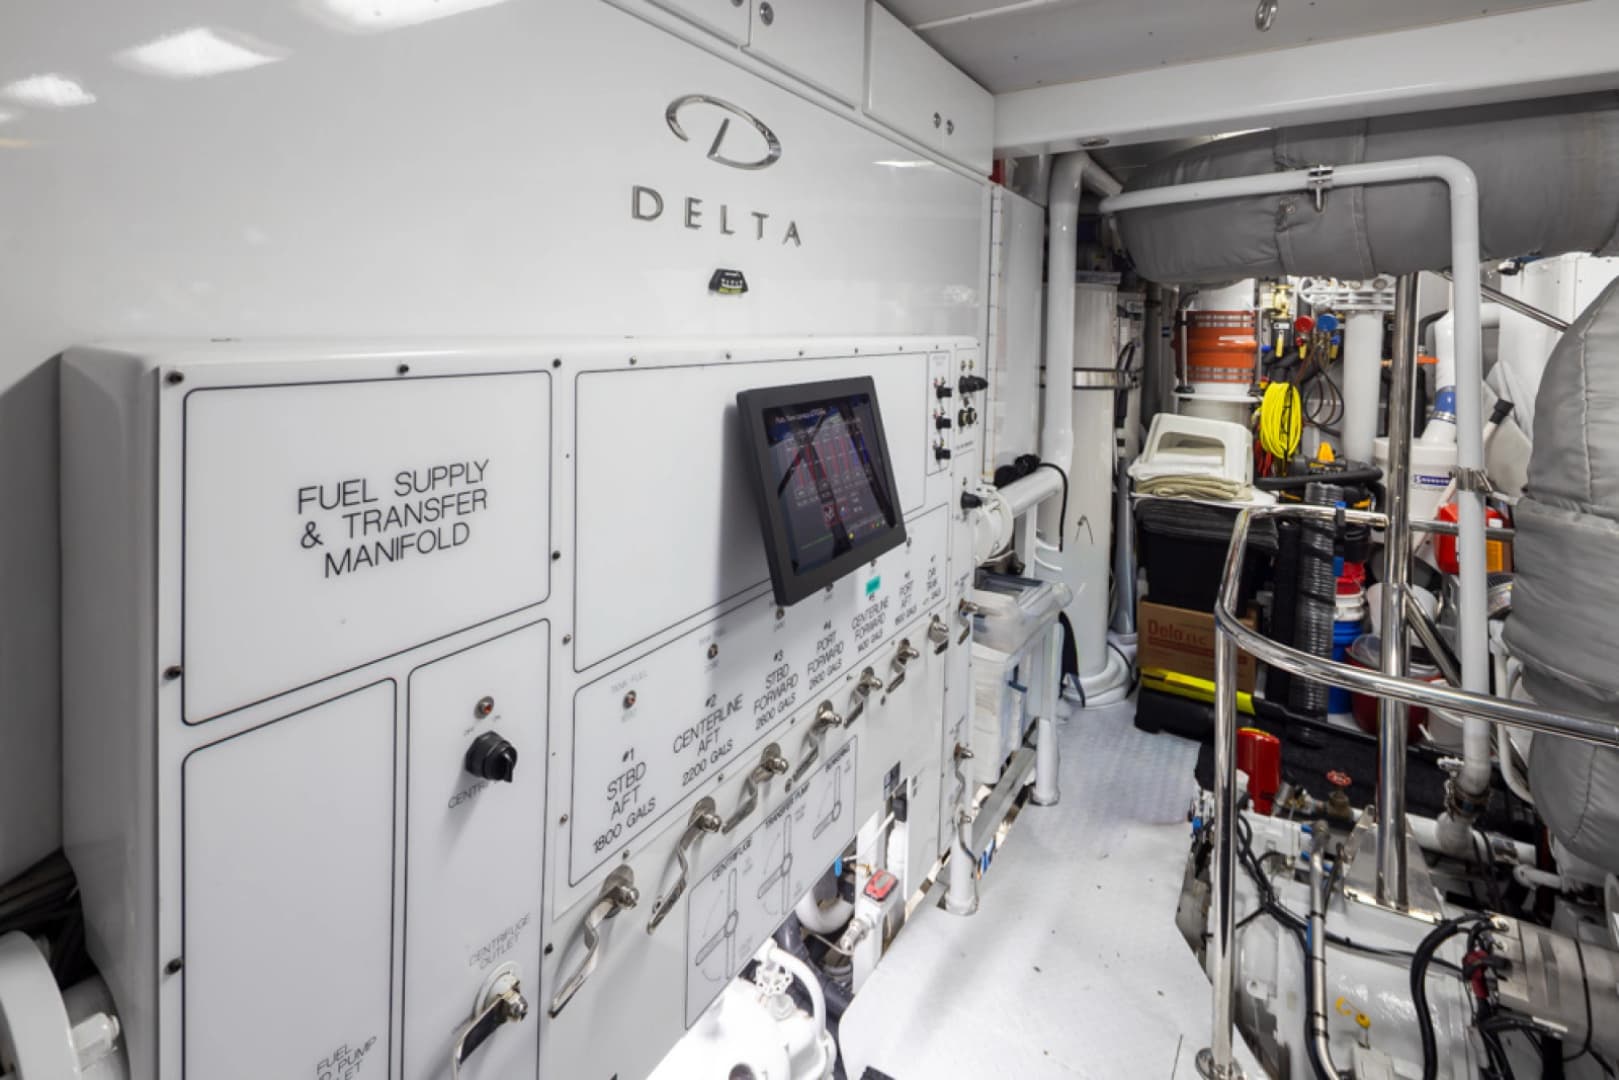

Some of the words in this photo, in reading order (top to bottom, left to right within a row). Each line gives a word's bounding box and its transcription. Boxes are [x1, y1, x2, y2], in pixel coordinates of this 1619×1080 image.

[631, 185, 802, 247] DELTA
[298, 478, 379, 514] FUEL
[394, 459, 489, 497] SUPPLY
[300, 521, 324, 549] &
[342, 488, 487, 539] TRANSFER
[325, 522, 470, 578] MANIFOLD
[851, 596, 889, 630] CENTERLINE
[854, 612, 886, 641] FORWARD
[773, 649, 783, 662] #3
[807, 641, 844, 675] FORWARD
[816, 631, 836, 651] PORT
[753, 673, 799, 715] FORWARD
[765, 663, 790, 690] STBD
[705, 693, 717, 708] #2
[777, 692, 796, 719] GALS
[673, 694, 743, 754] CENTERLINE
[622, 748, 635, 763] #1
[697, 728, 720, 756] AFT
[682, 759, 707, 787] 2200
[710, 739, 734, 764] GALS
[606, 761, 647, 801] STBD
[610, 784, 641, 820] AFT
[592, 824, 622, 854] 1800
[626, 797, 656, 828] GALS
[316, 1043, 352, 1074] FUEL
[338, 1036, 377, 1073] PUMP
